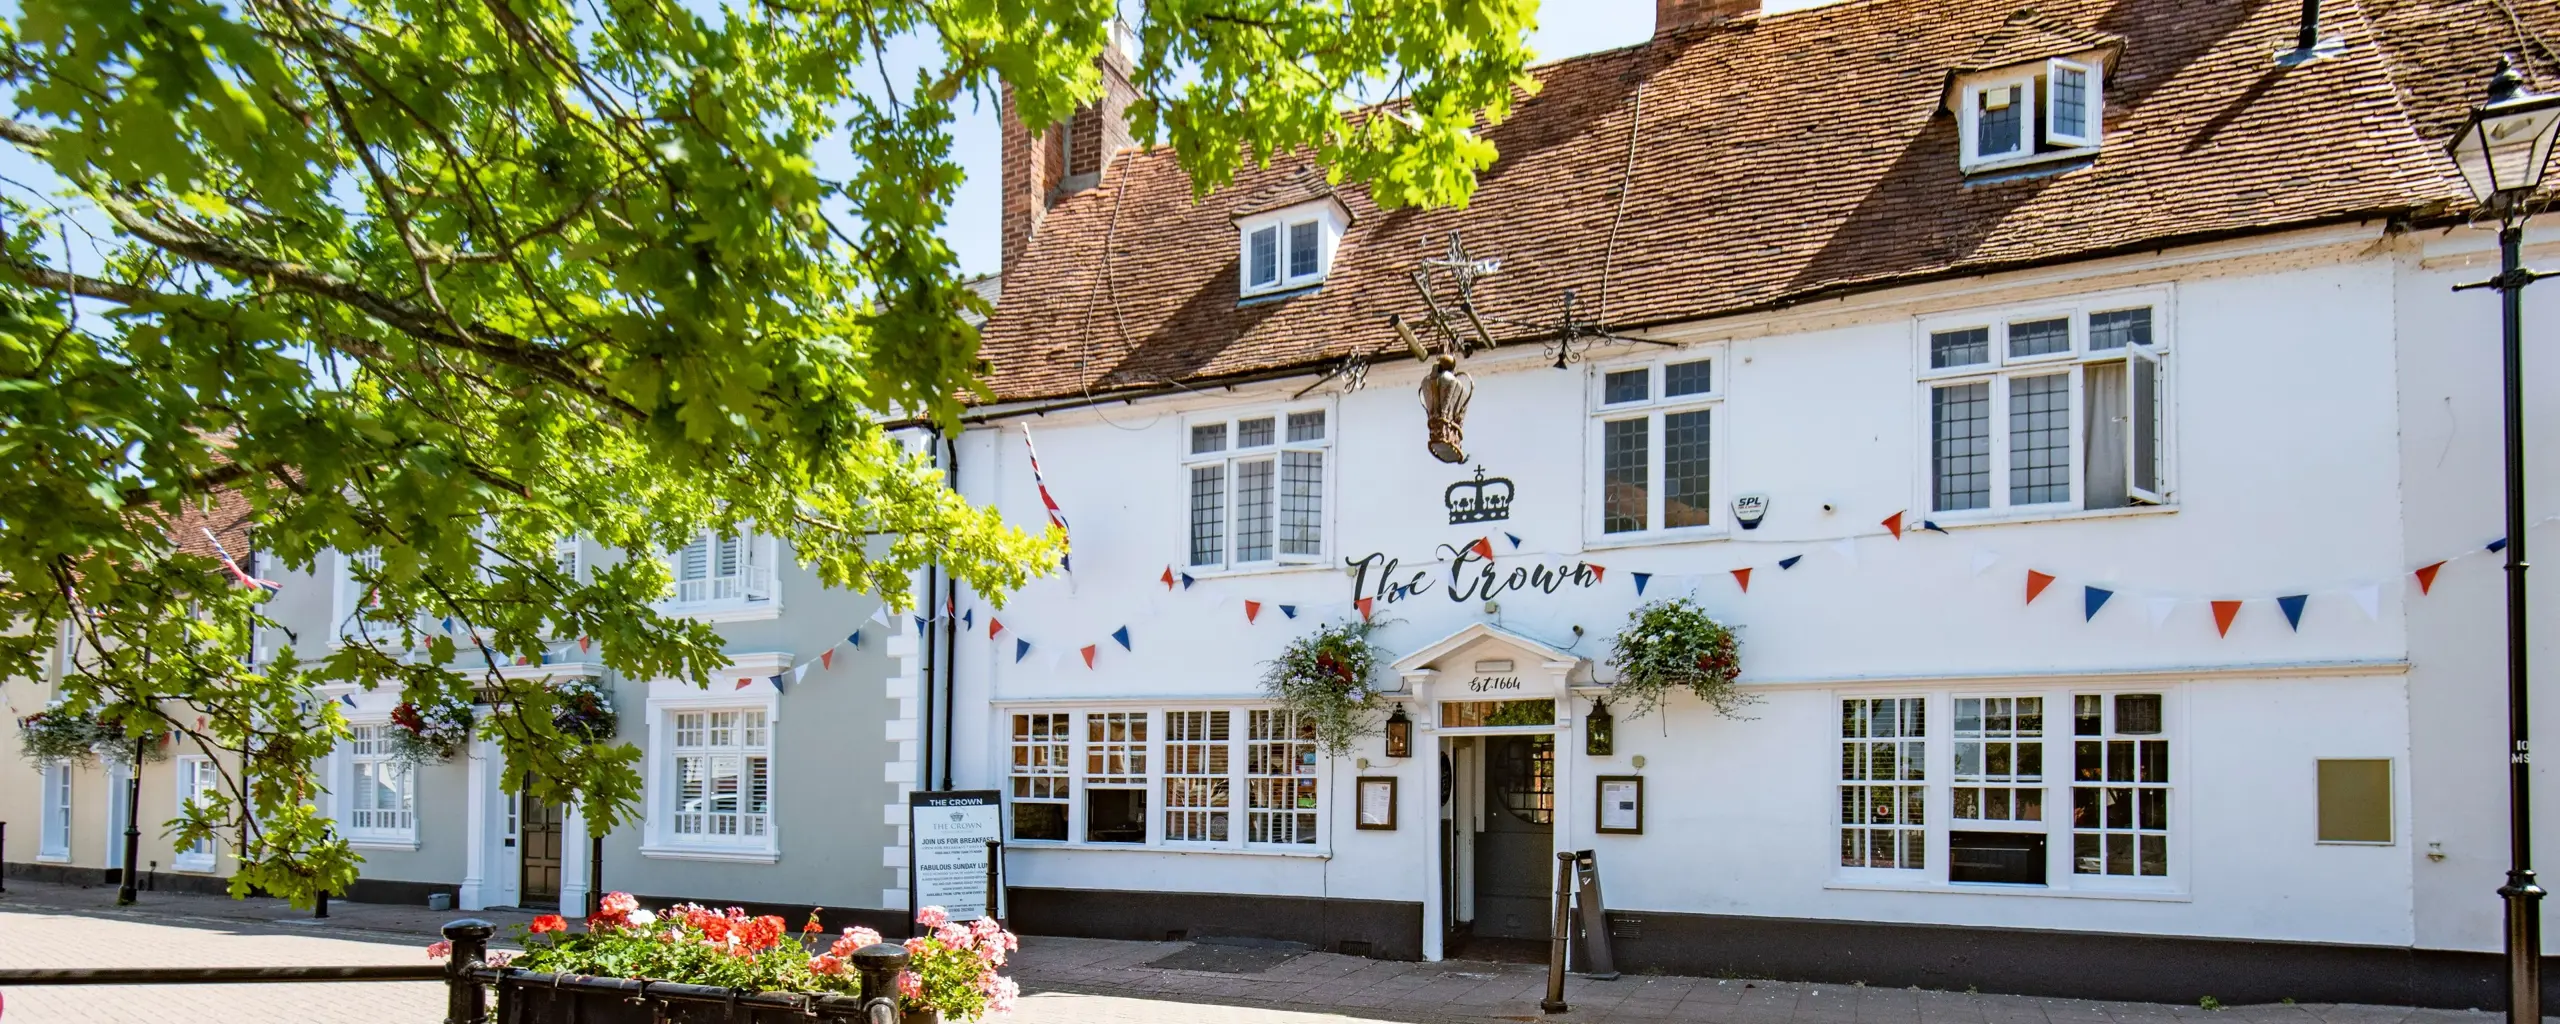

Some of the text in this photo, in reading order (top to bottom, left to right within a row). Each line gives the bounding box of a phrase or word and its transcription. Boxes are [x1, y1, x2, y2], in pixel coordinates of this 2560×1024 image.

[1739, 496, 1761, 506] SPL
[1345, 538, 1598, 610] The Crown
[949, 798, 983, 806] CROWN
[950, 822, 982, 830] CROWN
[960, 836, 994, 844] BREAKFAST
